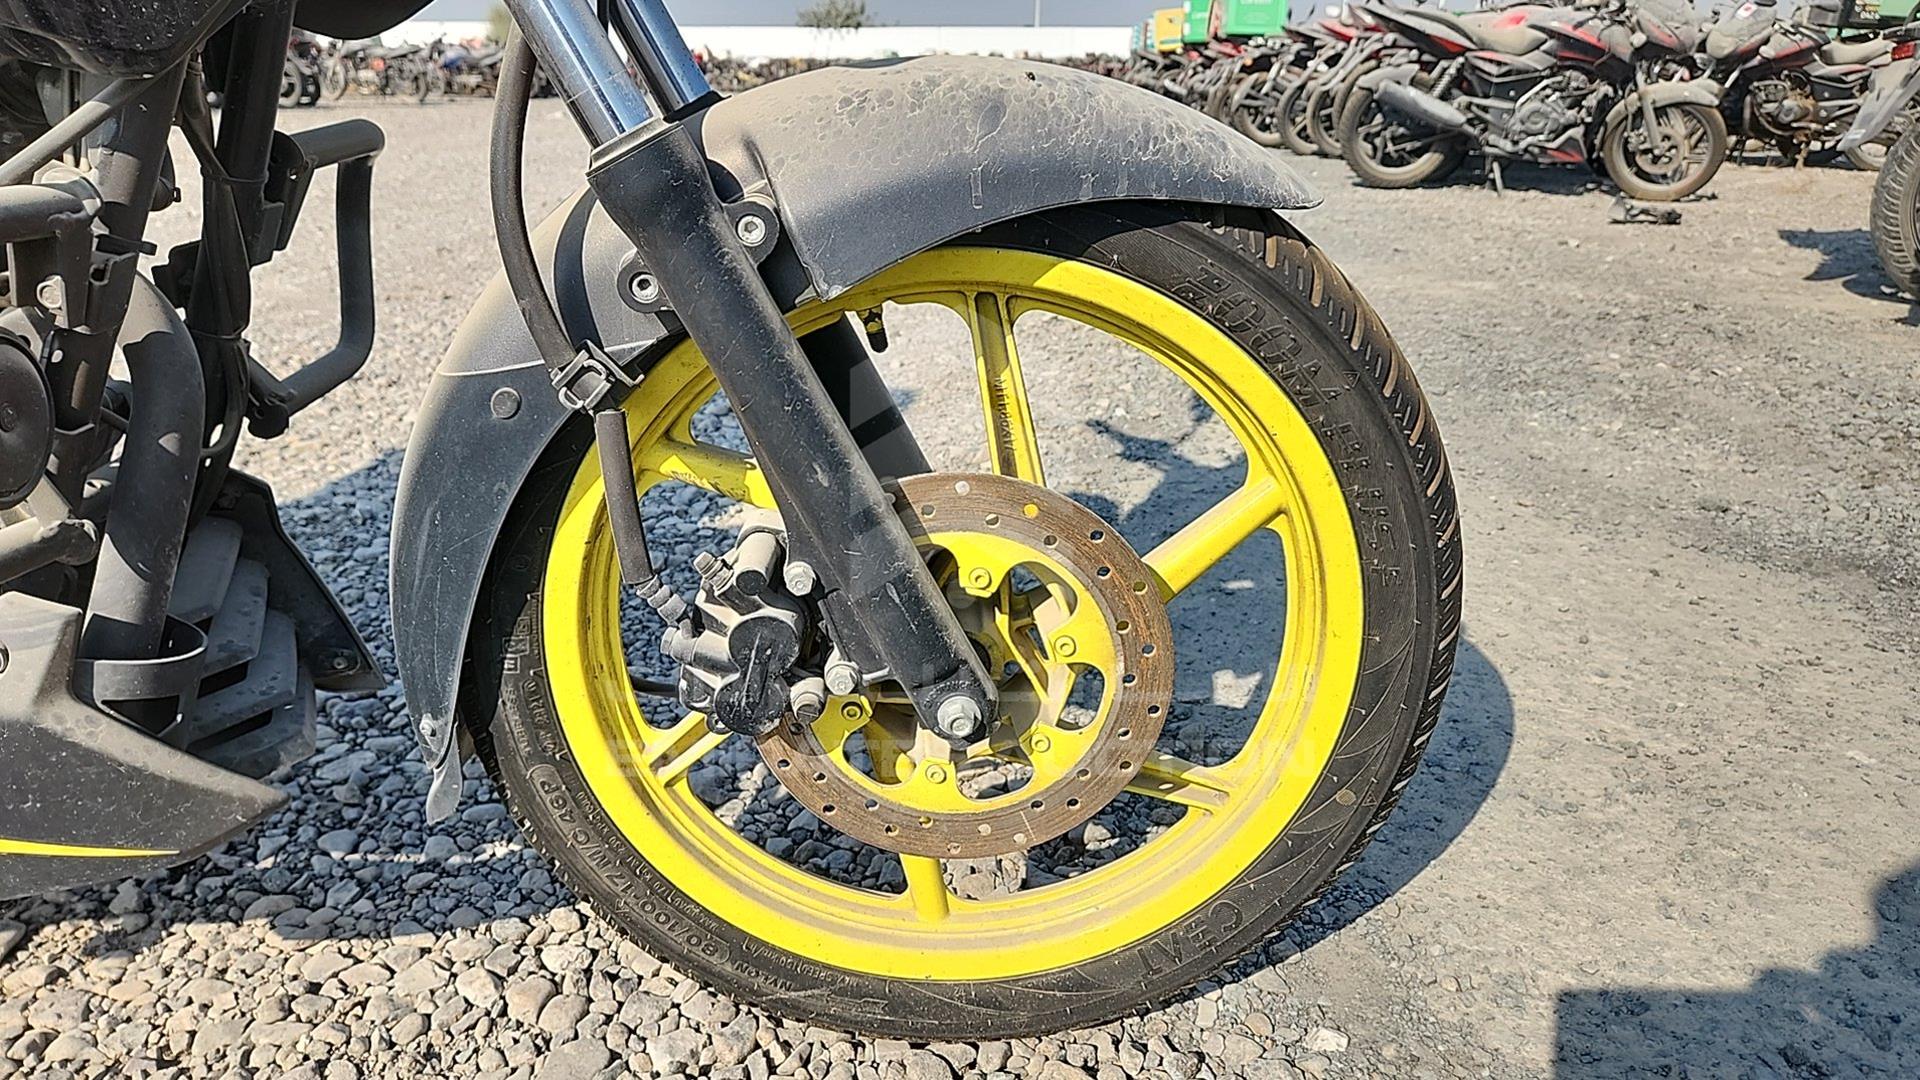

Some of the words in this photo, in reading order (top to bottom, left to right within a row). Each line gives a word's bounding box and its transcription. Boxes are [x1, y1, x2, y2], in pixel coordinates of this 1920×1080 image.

[1174, 264, 1342, 409] ZOOM
[539, 778, 576, 825] 46P
[570, 828, 611, 869] M/C
[607, 870, 718, 958] 80/100-17
[1136, 899, 1243, 980] CEAT
